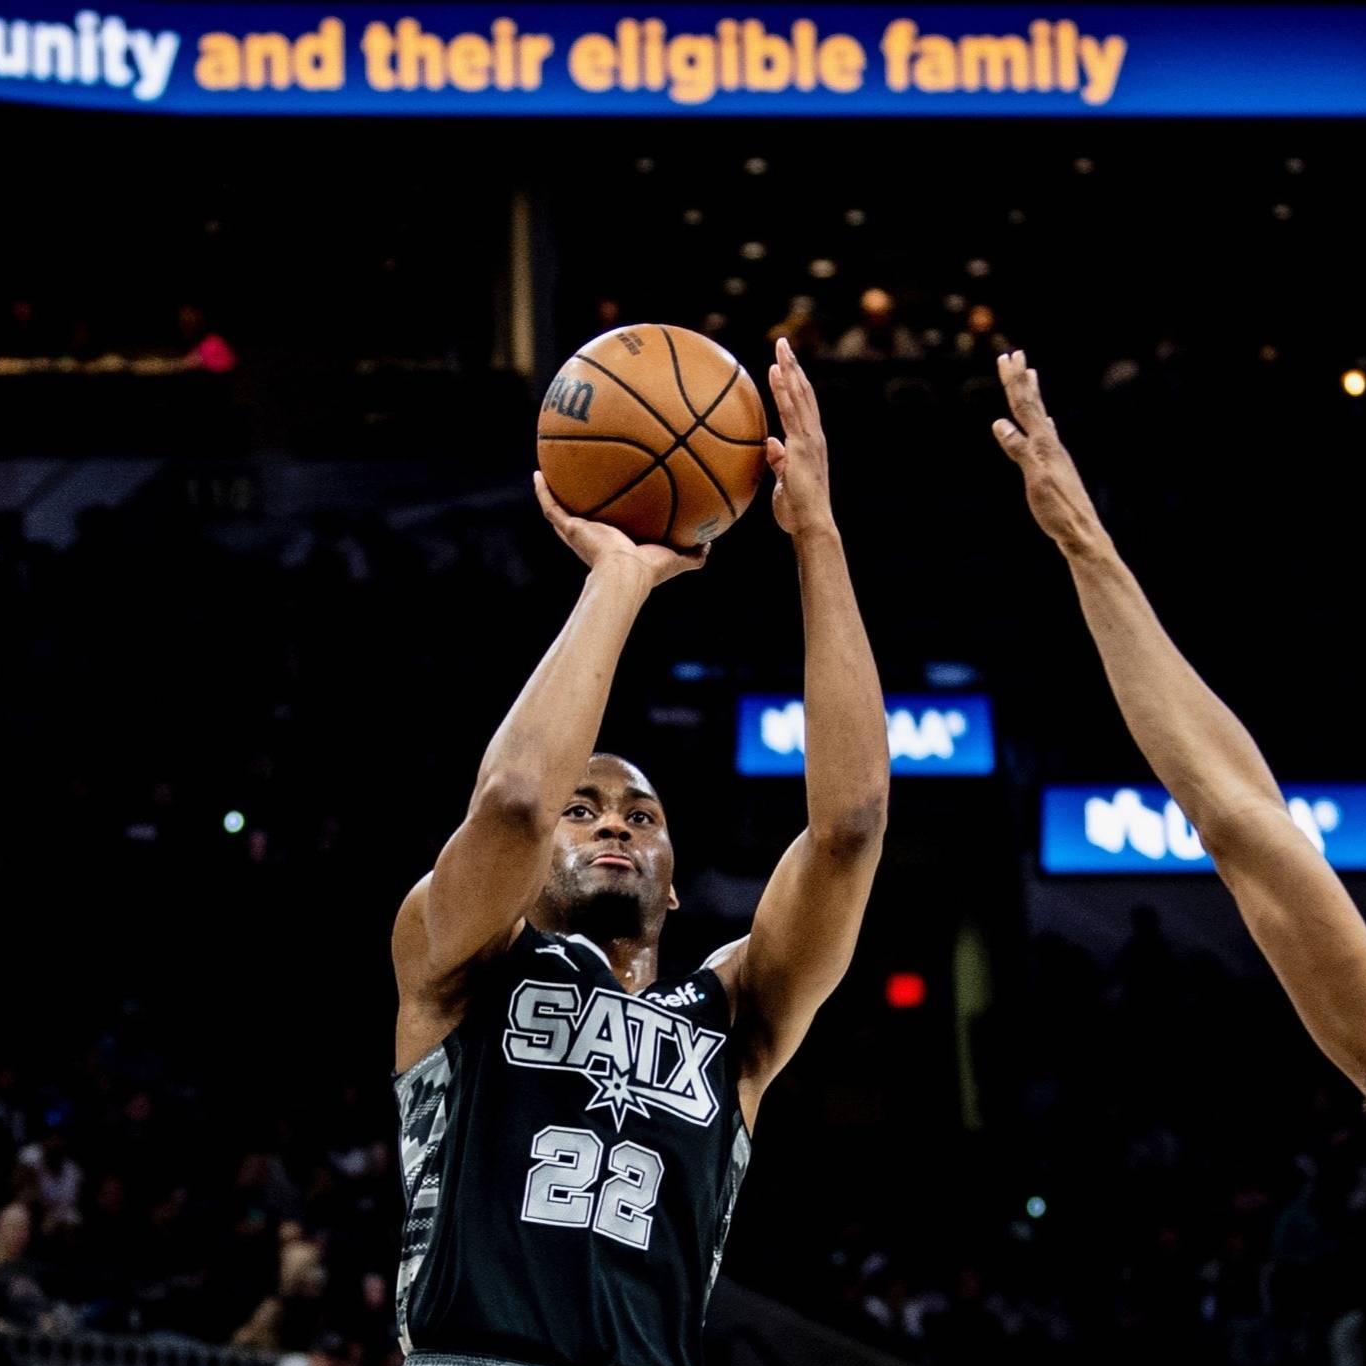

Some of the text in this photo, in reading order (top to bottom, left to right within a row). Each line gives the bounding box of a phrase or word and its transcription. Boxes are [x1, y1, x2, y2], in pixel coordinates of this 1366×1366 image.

[195, 18, 344, 92] and
[361, 18, 554, 92] their
[568, 18, 866, 104] eligible
[881, 18, 1127, 104] family
[502, 979, 726, 1130] SATX
[521, 1125, 665, 1250] 22
